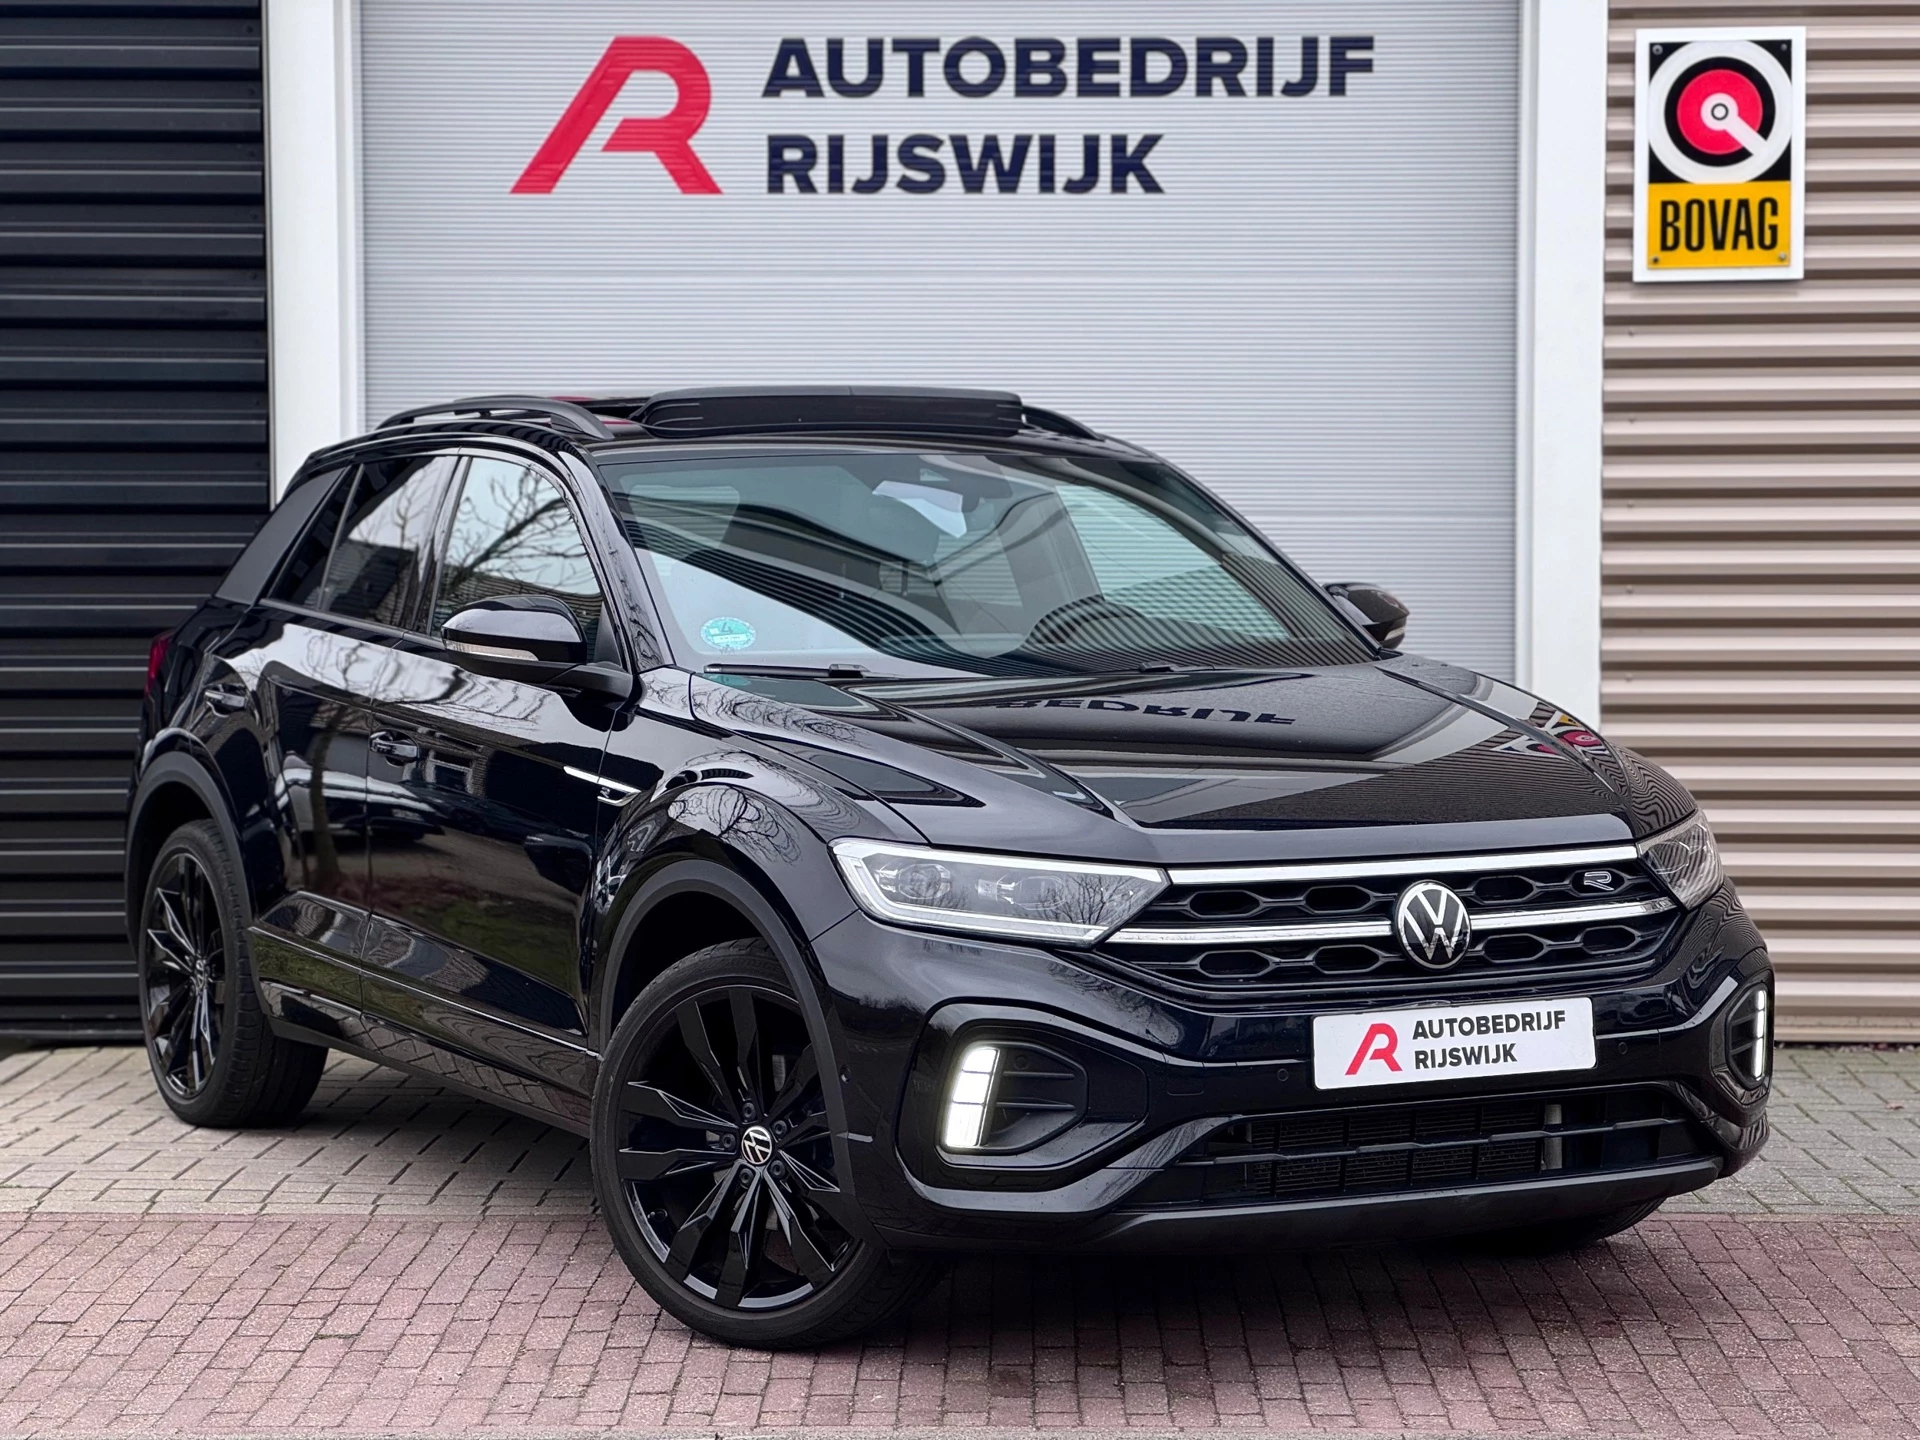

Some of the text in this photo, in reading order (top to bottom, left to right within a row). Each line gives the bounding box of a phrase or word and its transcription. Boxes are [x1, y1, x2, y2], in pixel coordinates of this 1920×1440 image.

[761, 36, 1375, 98] AUTOBEDRIJF
[766, 133, 1165, 195] RIJSWIJK
[1659, 197, 1779, 252] BOVAG
[1583, 870, 1614, 891] R
[1412, 1010, 1566, 1040] AUTOBEDRIJF
[1414, 1043, 1517, 1070] RIJSWIJK
